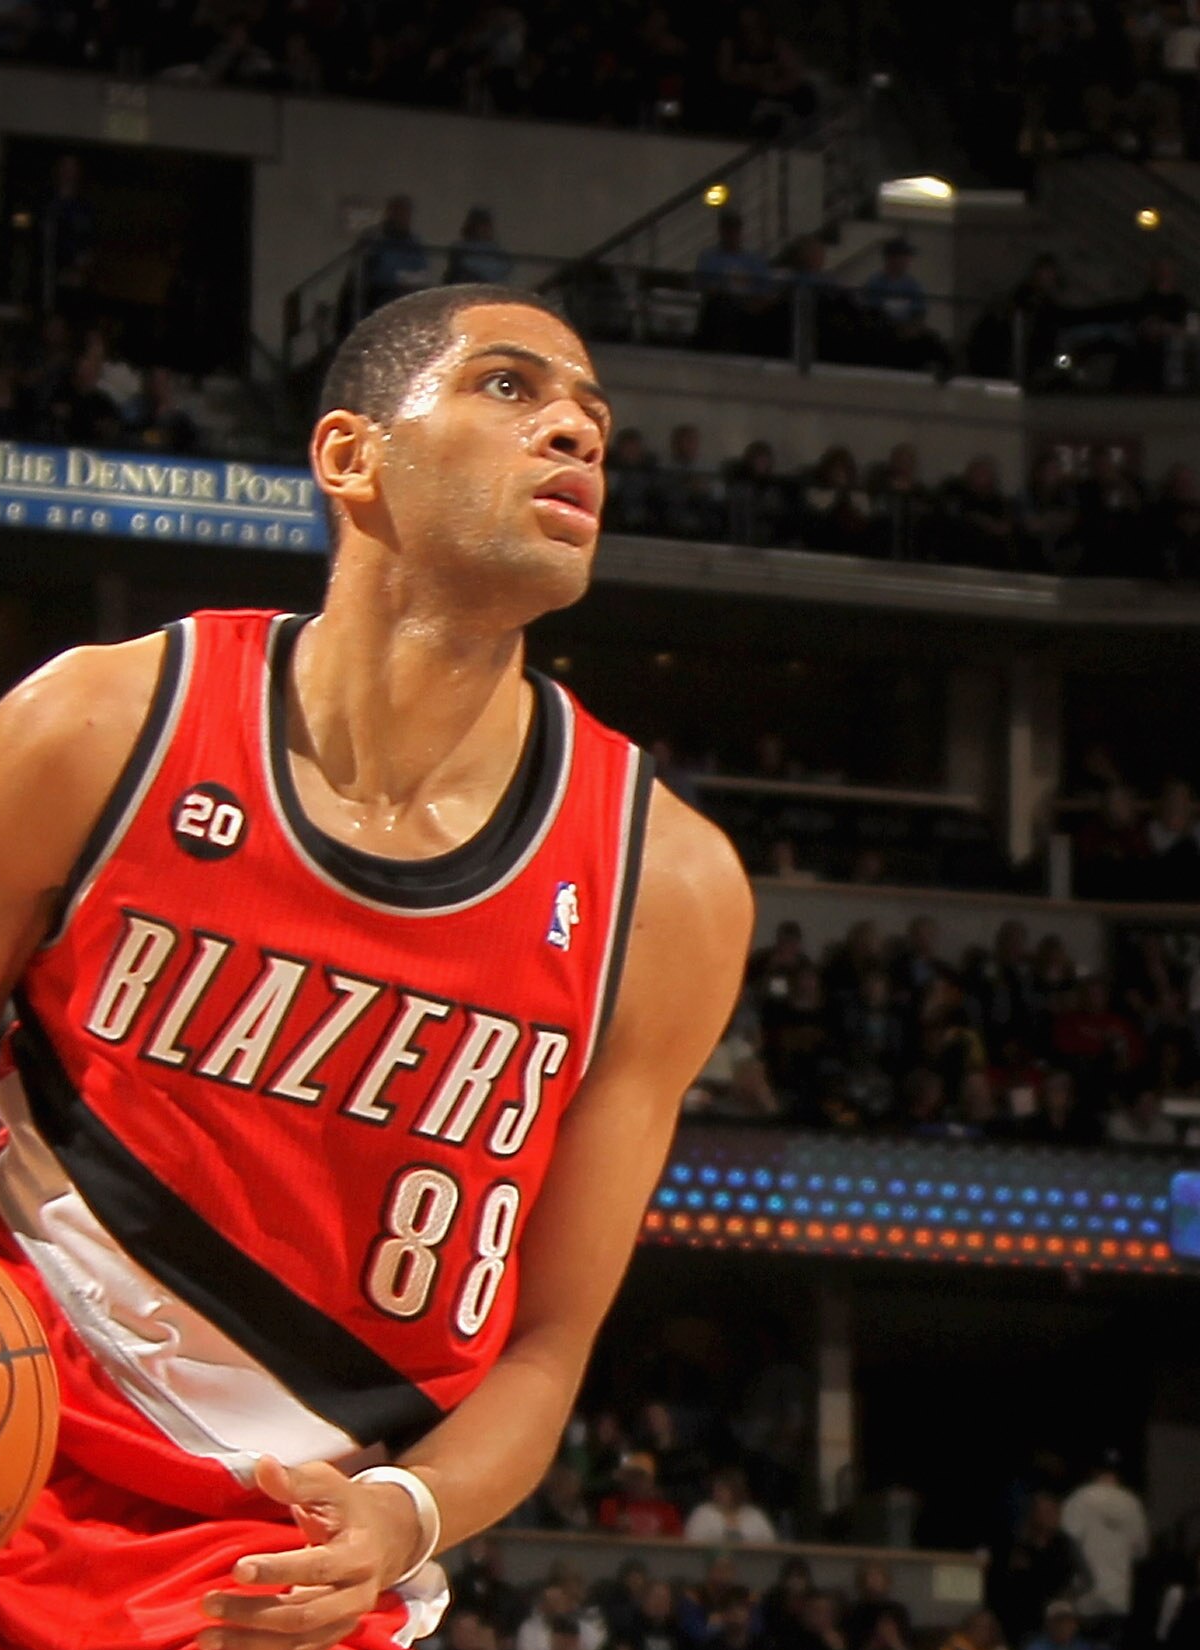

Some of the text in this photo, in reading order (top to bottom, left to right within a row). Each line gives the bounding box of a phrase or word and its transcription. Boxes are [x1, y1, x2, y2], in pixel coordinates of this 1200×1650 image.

[63, 447, 217, 499] DENVER
[223, 463, 315, 508] POST
[46, 502, 107, 529] are
[129, 512, 306, 544] colorado
[176, 793, 244, 848] 20
[86, 907, 571, 1157] BLAZERS
[362, 1163, 521, 1339] 88
